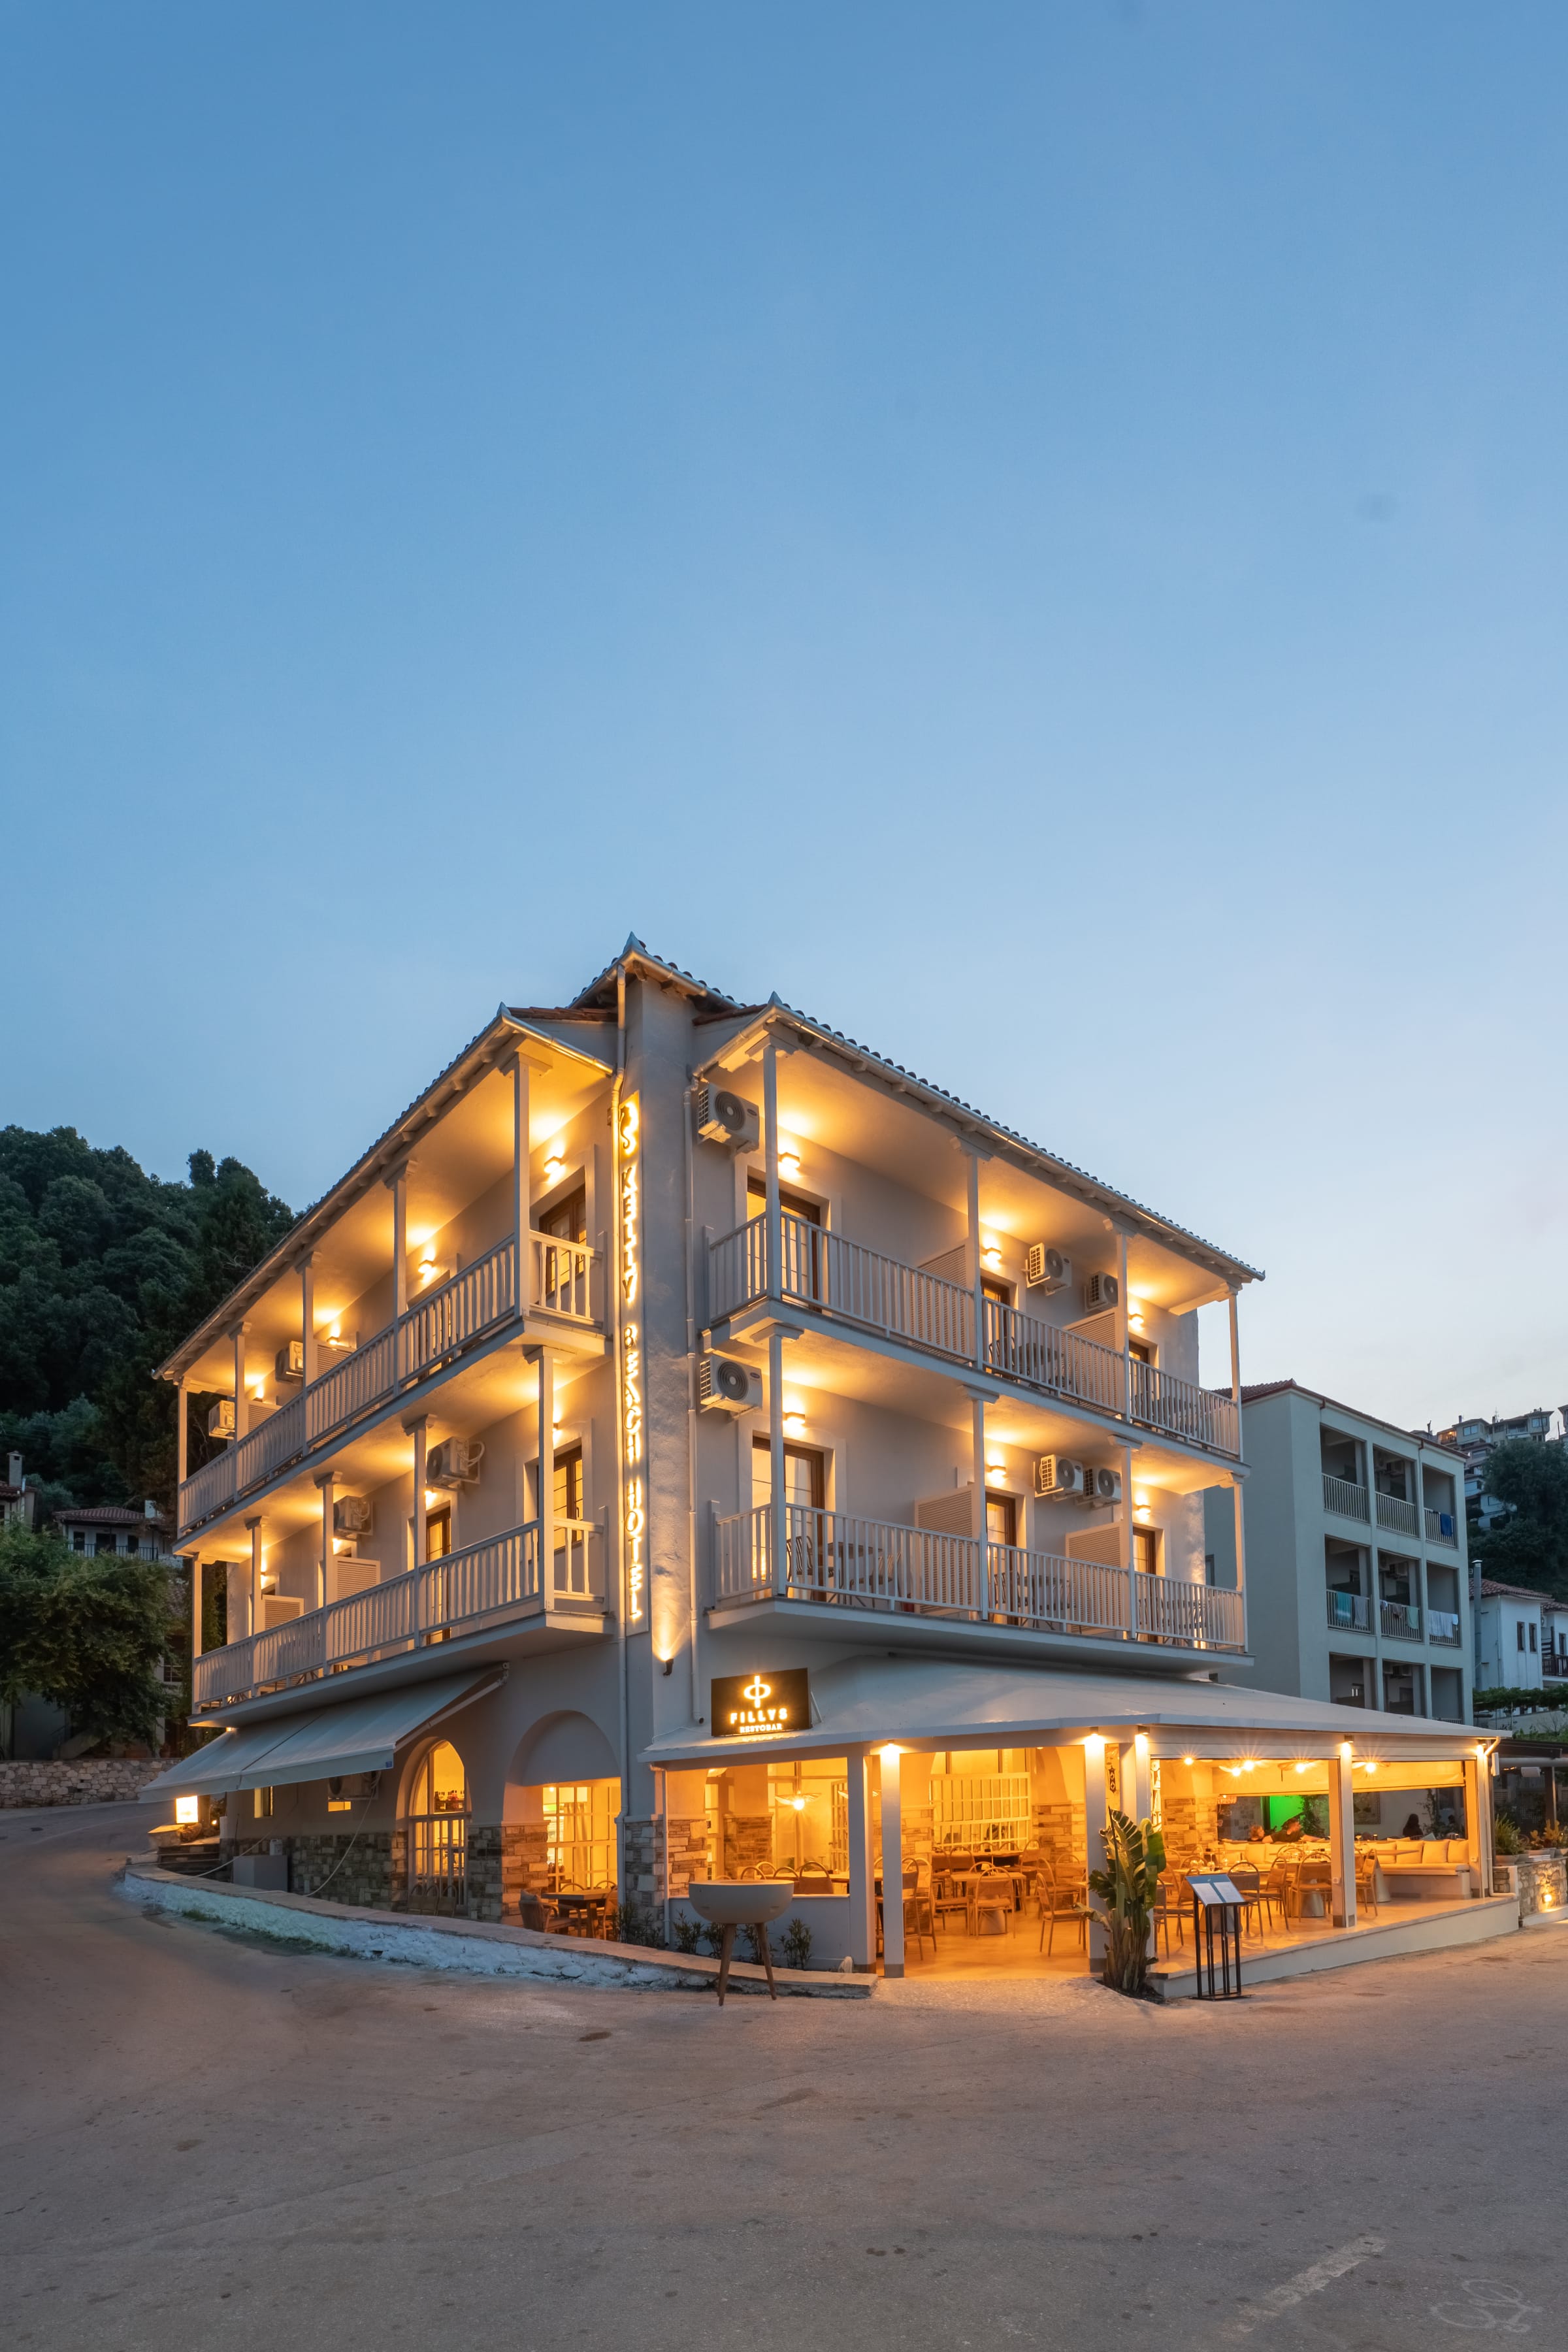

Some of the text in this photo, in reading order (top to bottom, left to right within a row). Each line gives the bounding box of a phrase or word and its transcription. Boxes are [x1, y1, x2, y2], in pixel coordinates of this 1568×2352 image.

[621, 1164, 644, 1619] KELLY BEACH HOTEL
[740, 1723, 783, 1733] RESTOBAR
